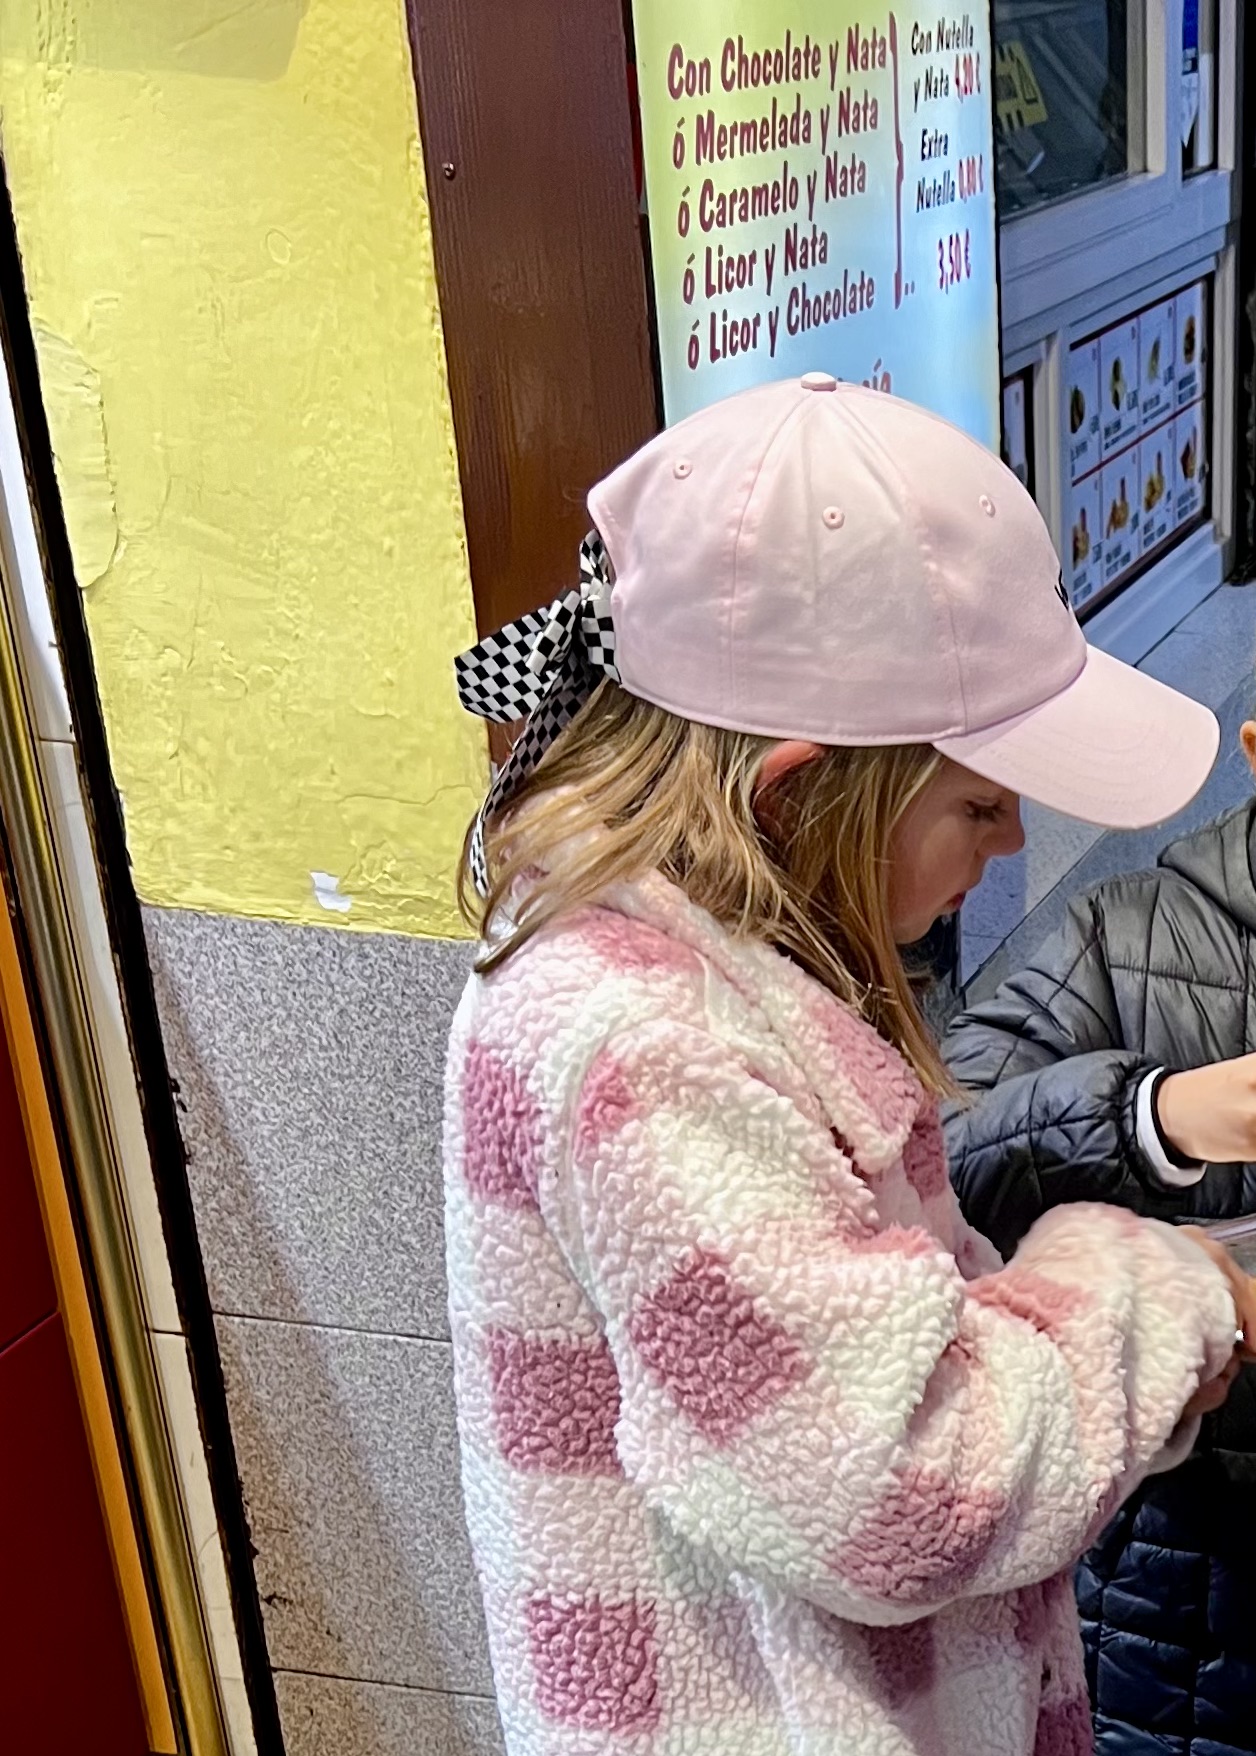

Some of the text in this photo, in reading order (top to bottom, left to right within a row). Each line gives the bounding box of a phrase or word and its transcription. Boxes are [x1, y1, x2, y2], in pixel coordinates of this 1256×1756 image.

[668, 22, 887, 99] Con Chocolate y Nata
[911, 14, 974, 56] Con Nutella
[914, 77, 920, 113] y
[924, 65, 949, 100] Nata
[672, 87, 878, 169] ó Mermelada y Nata
[921, 128, 949, 161] Extra
[678, 151, 866, 238] ó Caramelo y Nata
[916, 170, 955, 213] Nutella
[683, 223, 827, 304] ó Licor y Nata
[688, 269, 874, 370] ó Licor y Chocolate
